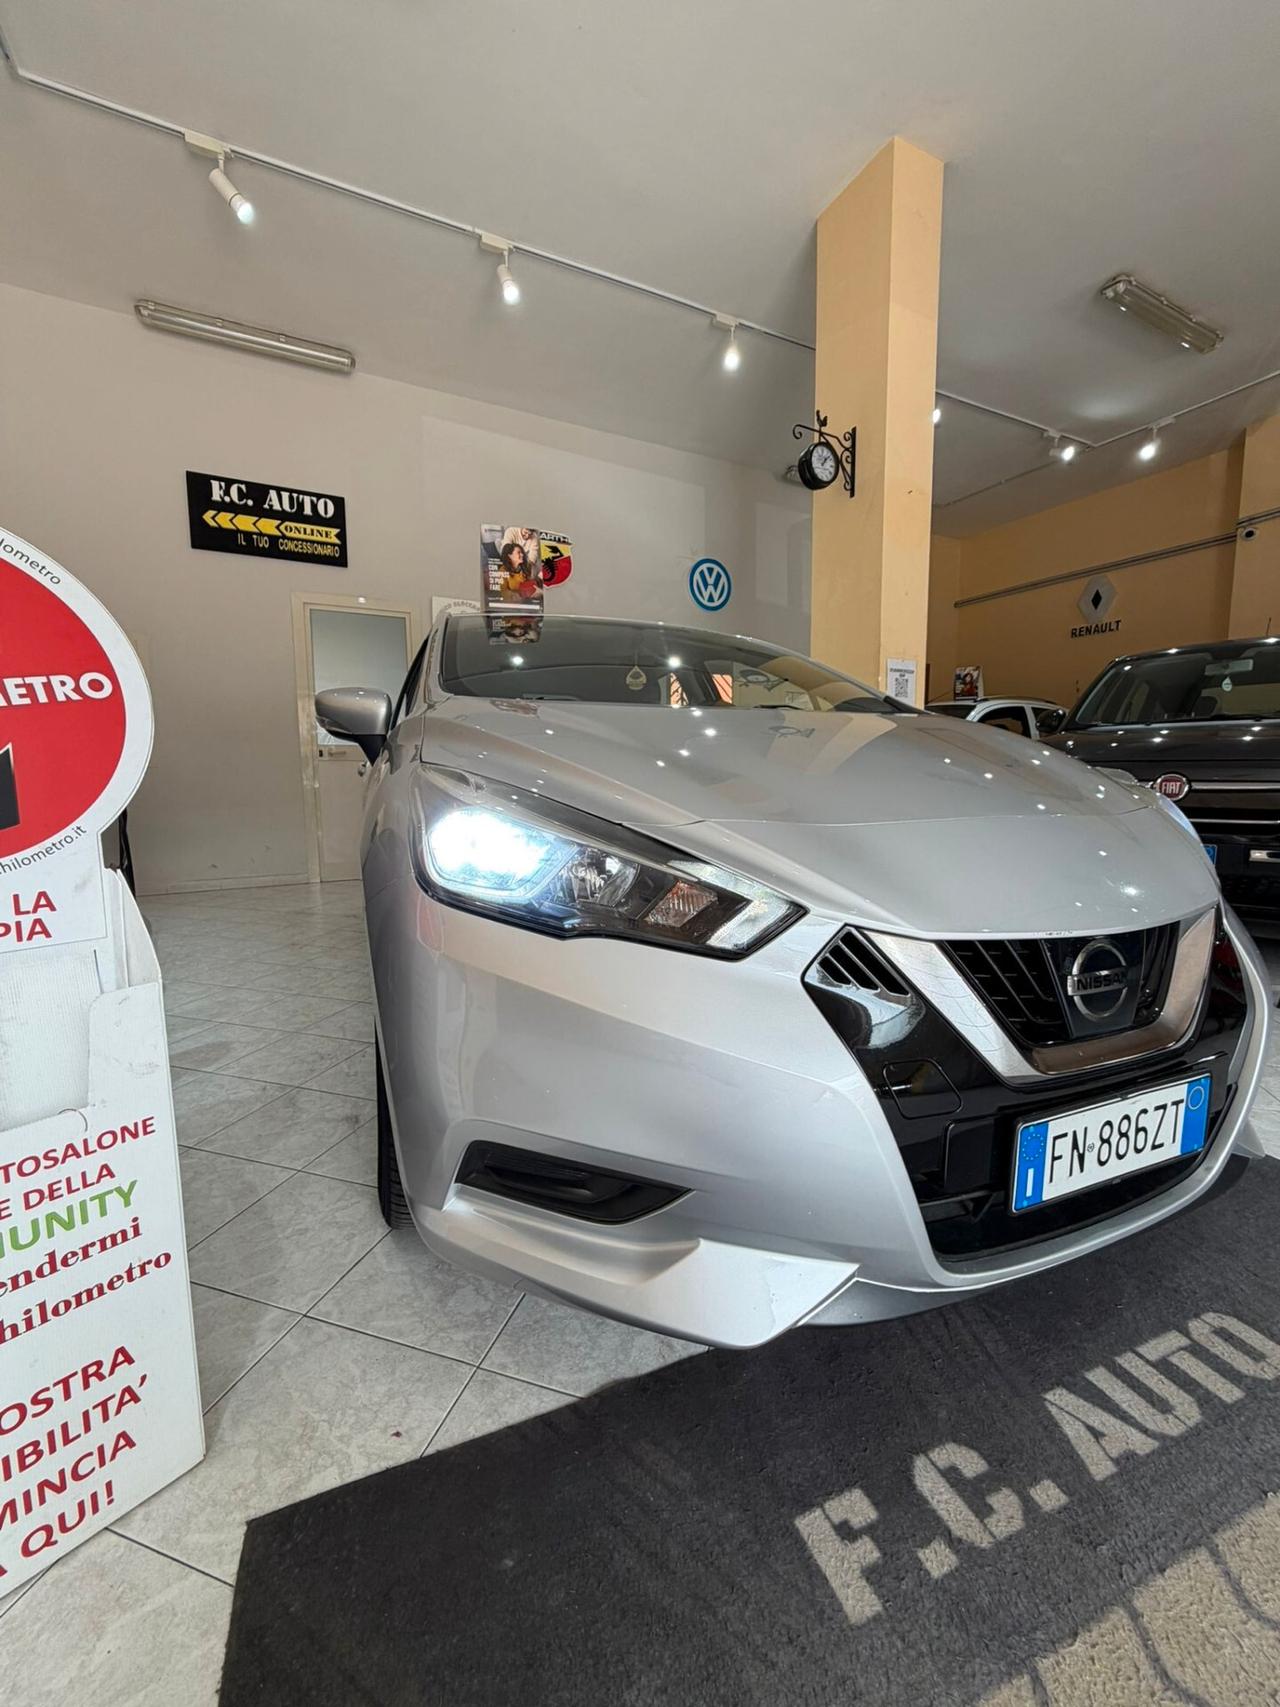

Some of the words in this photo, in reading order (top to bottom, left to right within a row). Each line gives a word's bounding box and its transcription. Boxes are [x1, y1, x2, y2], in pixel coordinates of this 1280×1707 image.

[210, 480, 253, 507] F.C.
[263, 489, 335, 519] AUTO
[237, 532, 247, 545] IL
[252, 534, 270, 549] TUO
[278, 540, 340, 558] CONCESSIONARIO
[284, 524, 333, 540] ONLINE
[1070, 619, 1122, 639] RENAULT
[1162, 781, 1181, 794] FIAT
[0, 825, 87, 874] hilometro.it
[12, 890, 57, 916] LA
[0, 1116, 156, 1185] TOSALONE
[22, 1163, 116, 1211] DELLA
[0, 1345, 136, 1436] OSTRA
[1041, 1311, 1280, 1482] AUTO
[20, 1479, 115, 1558] QUI!
